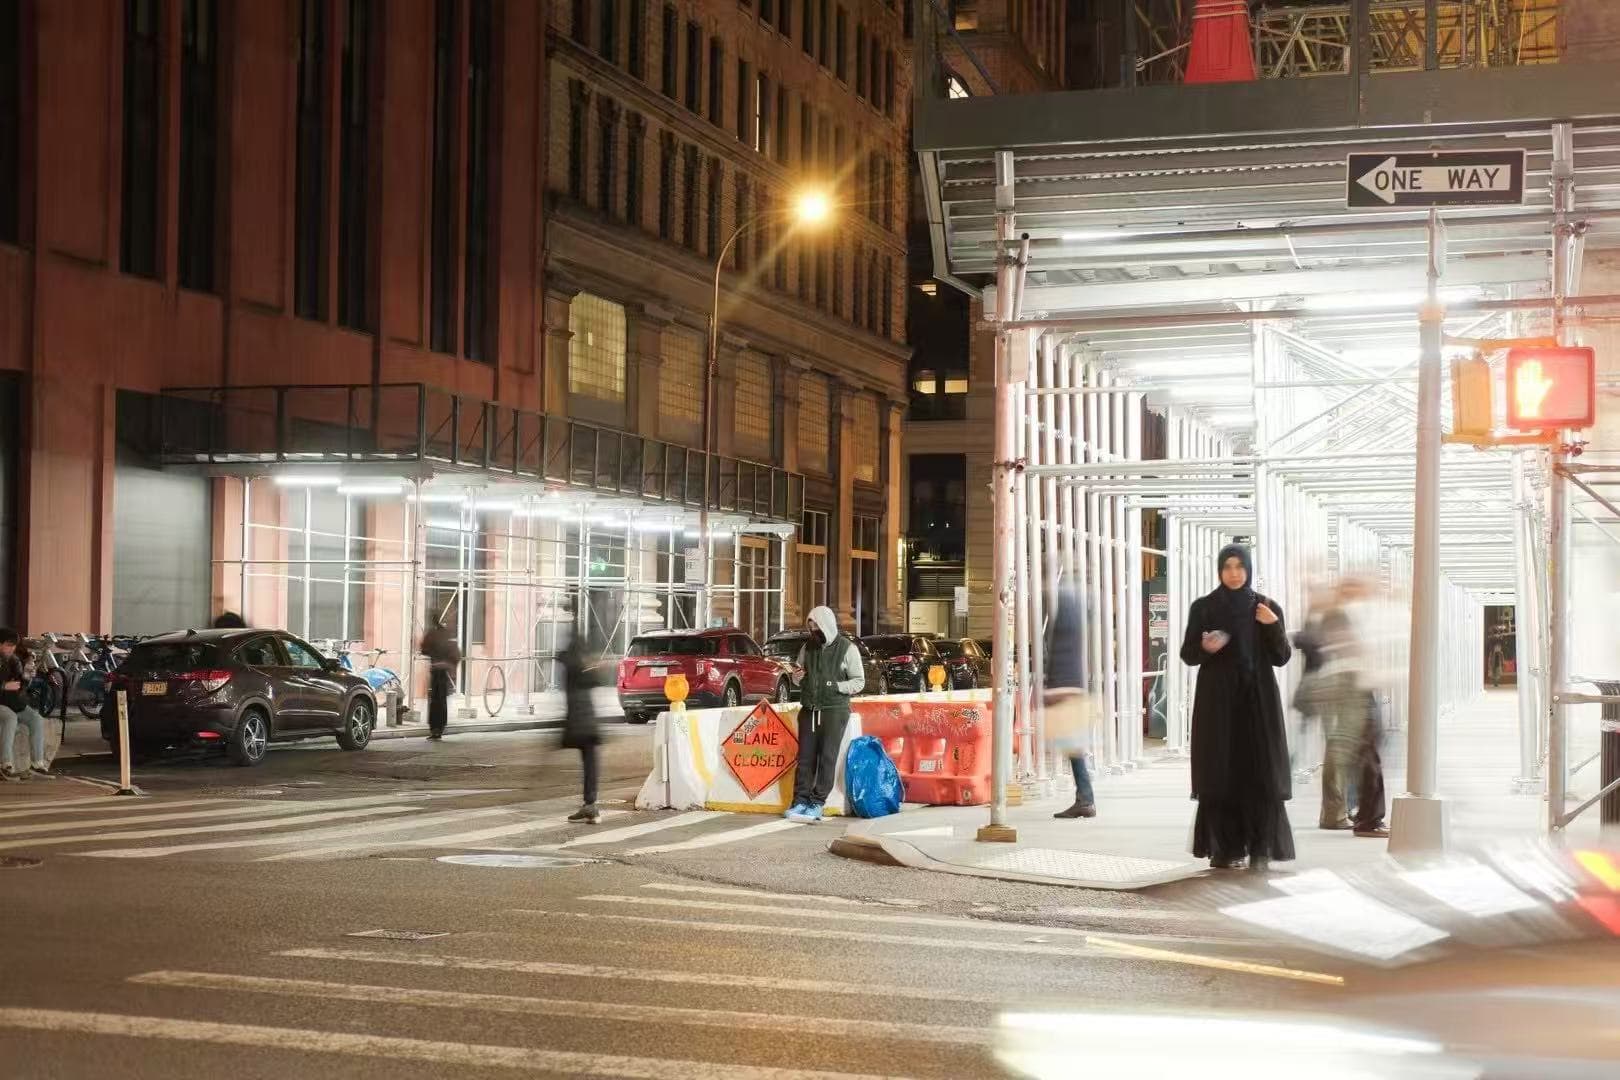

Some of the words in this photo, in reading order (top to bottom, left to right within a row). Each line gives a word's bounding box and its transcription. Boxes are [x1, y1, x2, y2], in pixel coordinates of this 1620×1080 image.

[1374, 169, 1422, 191] ONE
[1448, 167, 1500, 190] WAY
[743, 732, 779, 746] LANE
[733, 753, 785, 768] CLOSED
